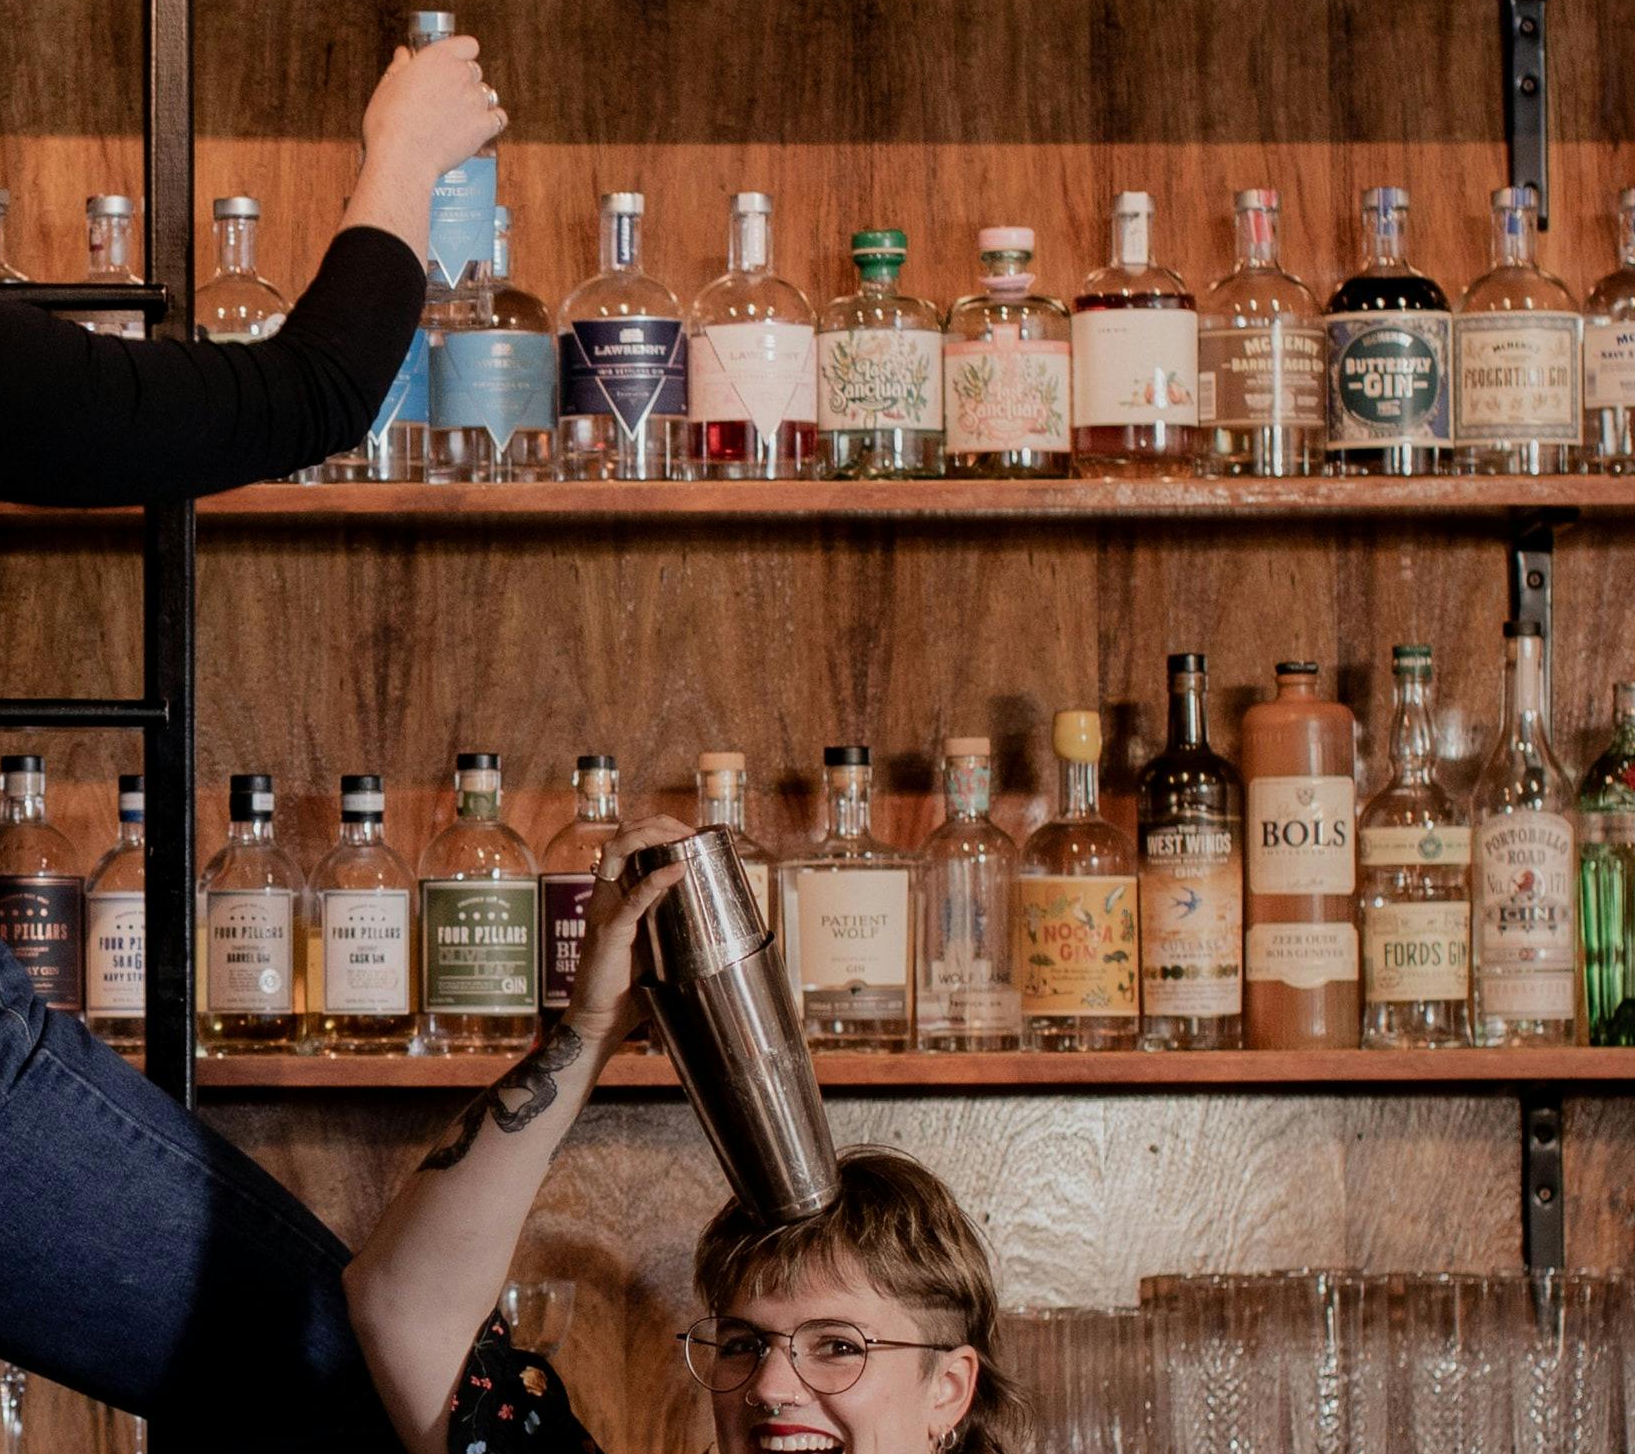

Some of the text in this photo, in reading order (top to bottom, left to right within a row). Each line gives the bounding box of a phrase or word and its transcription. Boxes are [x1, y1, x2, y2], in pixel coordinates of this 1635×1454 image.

[1363, 376, 1414, 397] GIN
[1260, 819, 1347, 849] BOLS
[1147, 831, 1232, 857] WEST WINDS
[1507, 850, 1547, 865] ROAD
[822, 915, 888, 926] PATIENT
[1498, 907, 1556, 923] GIN
[214, 926, 236, 940] FOUR
[332, 926, 355, 939] FOUR
[437, 925, 527, 945] FOUR PILLARS
[832, 927, 878, 939] WOLF
[1059, 944, 1096, 962] GIN
[1384, 942, 1443, 967] FORDS
[502, 978, 526, 992] GIN
[938, 971, 973, 986] WOLF
